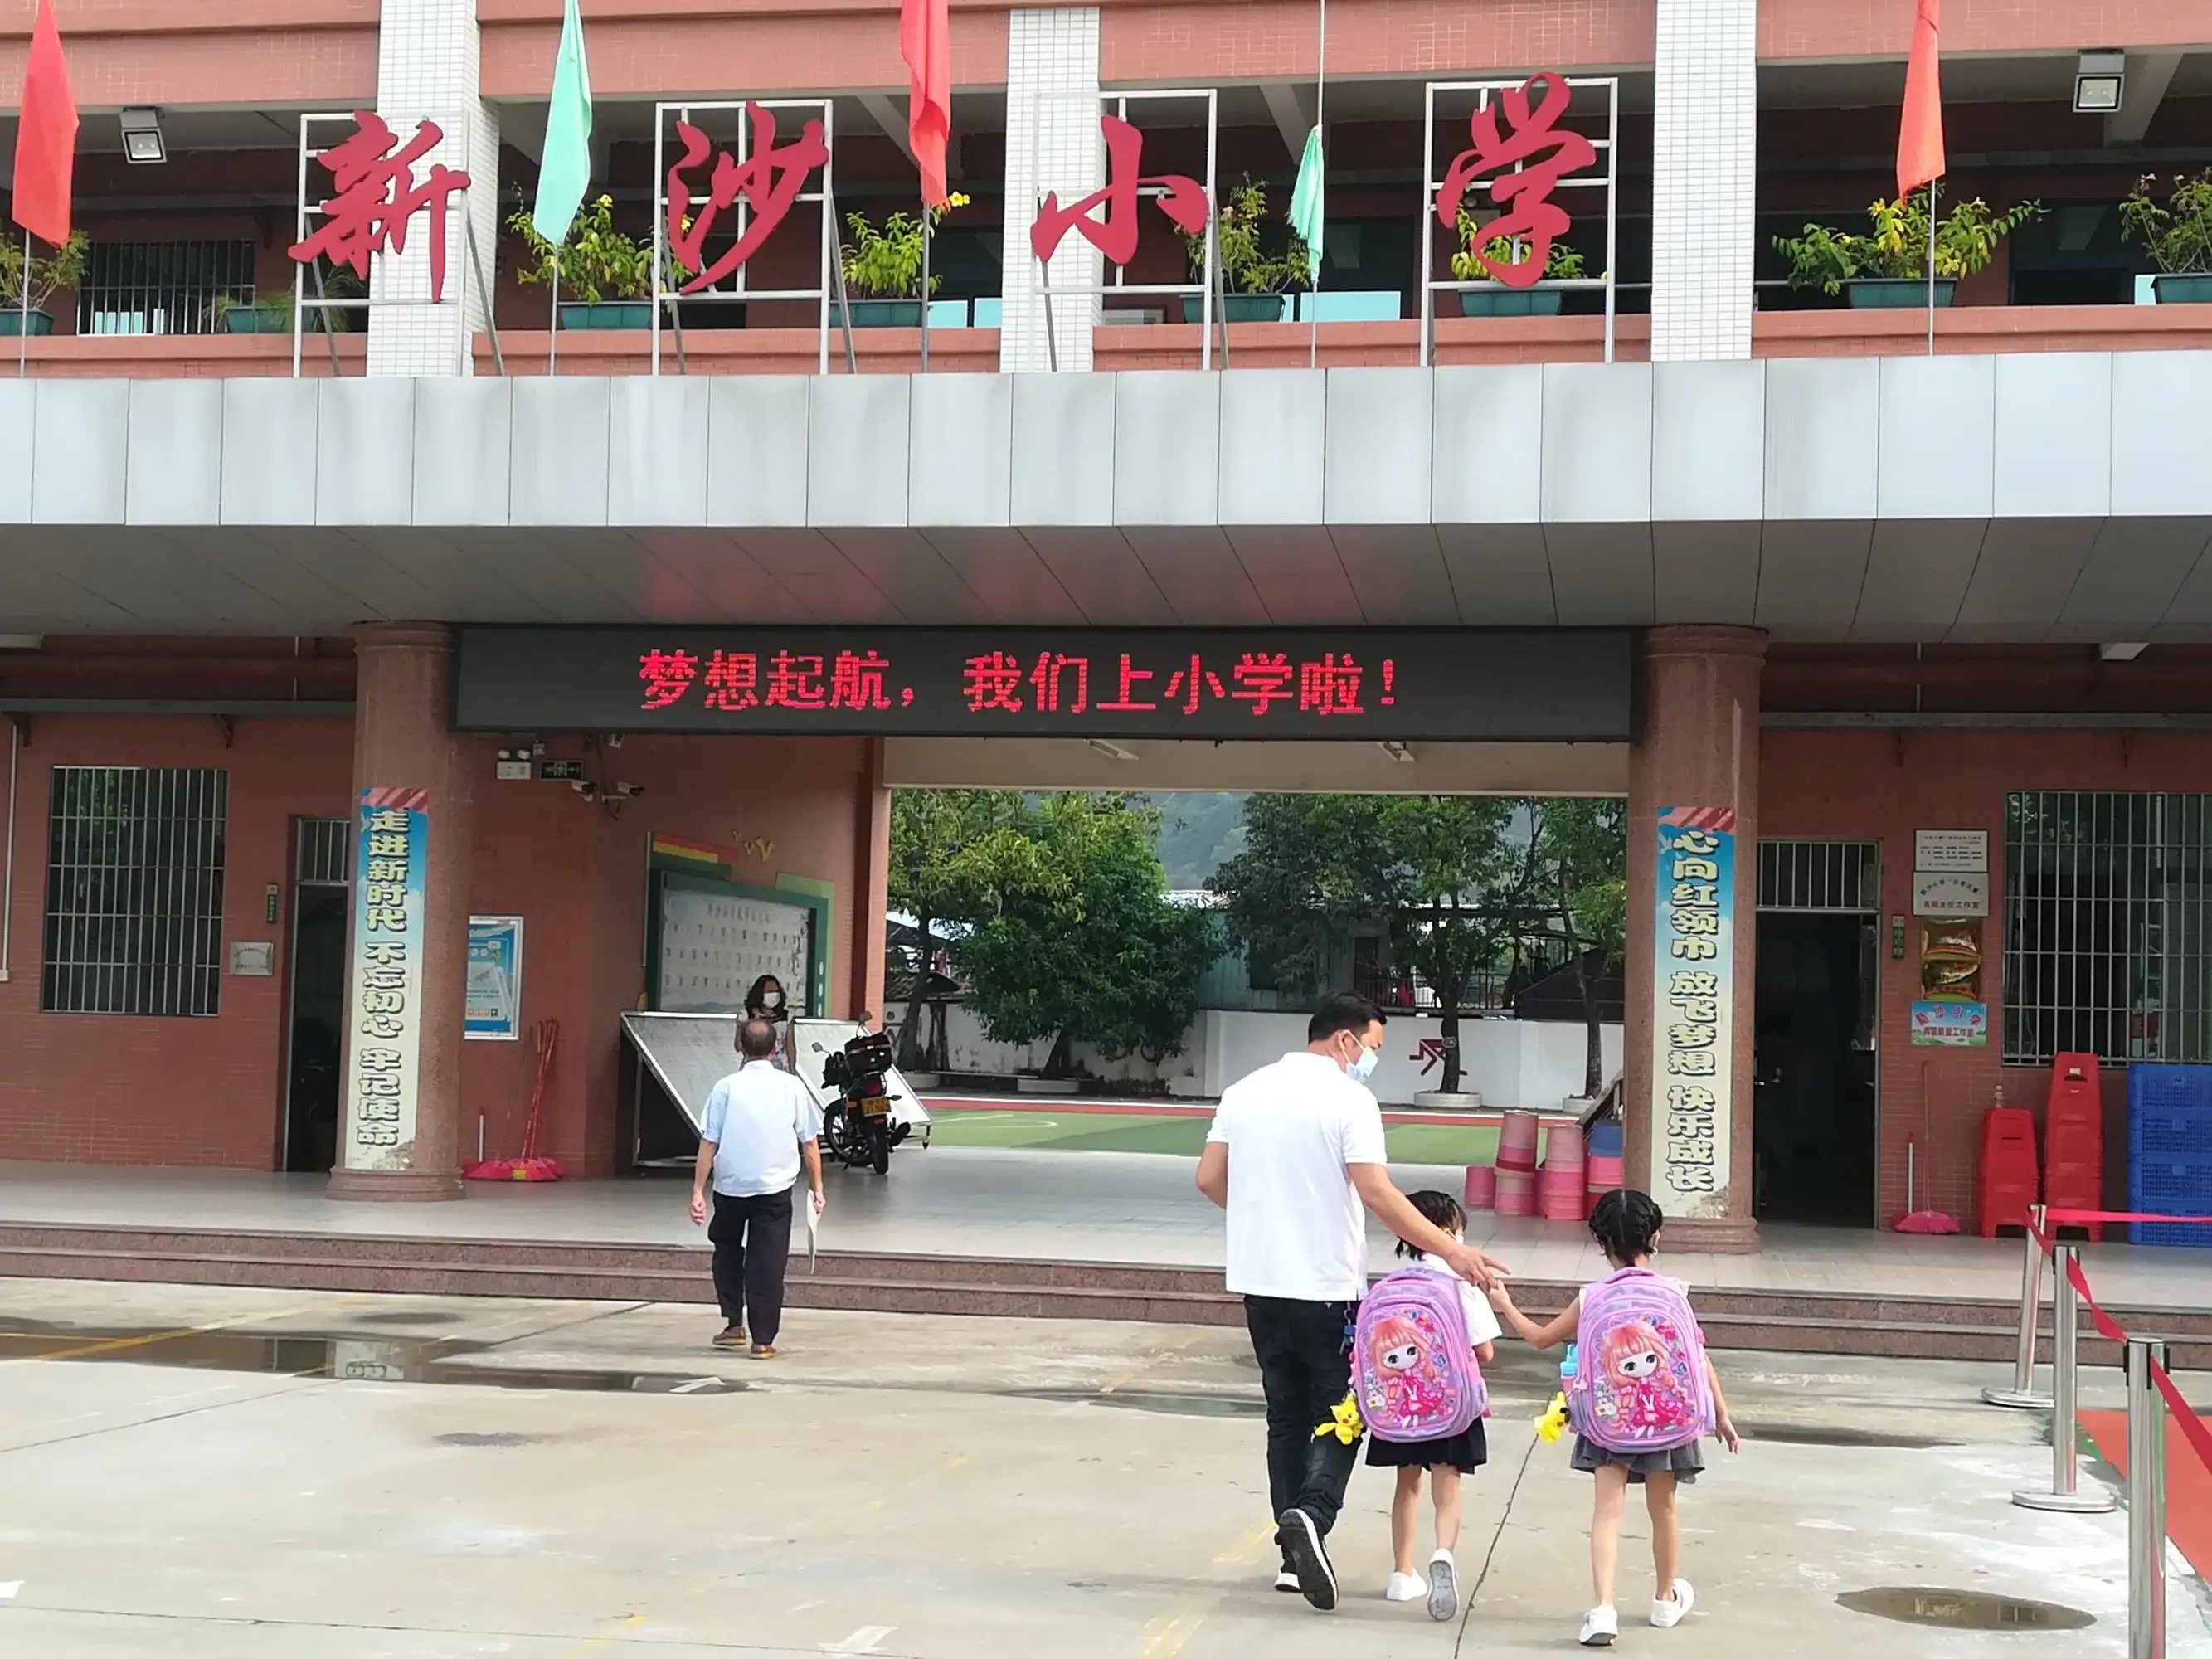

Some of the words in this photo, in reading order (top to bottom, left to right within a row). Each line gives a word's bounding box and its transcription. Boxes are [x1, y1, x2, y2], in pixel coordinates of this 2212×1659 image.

[288, 71, 1596, 301] 新沙小学
[367, 810, 410, 932] 走进新时代
[1670, 830, 1719, 961] 心向红领巾
[361, 941, 406, 1039] 不忘初心
[1667, 971, 1718, 1076] 放飞梦想
[357, 1047, 402, 1146] 牢记使命
[1665, 1084, 1716, 1193] 快乐成长
